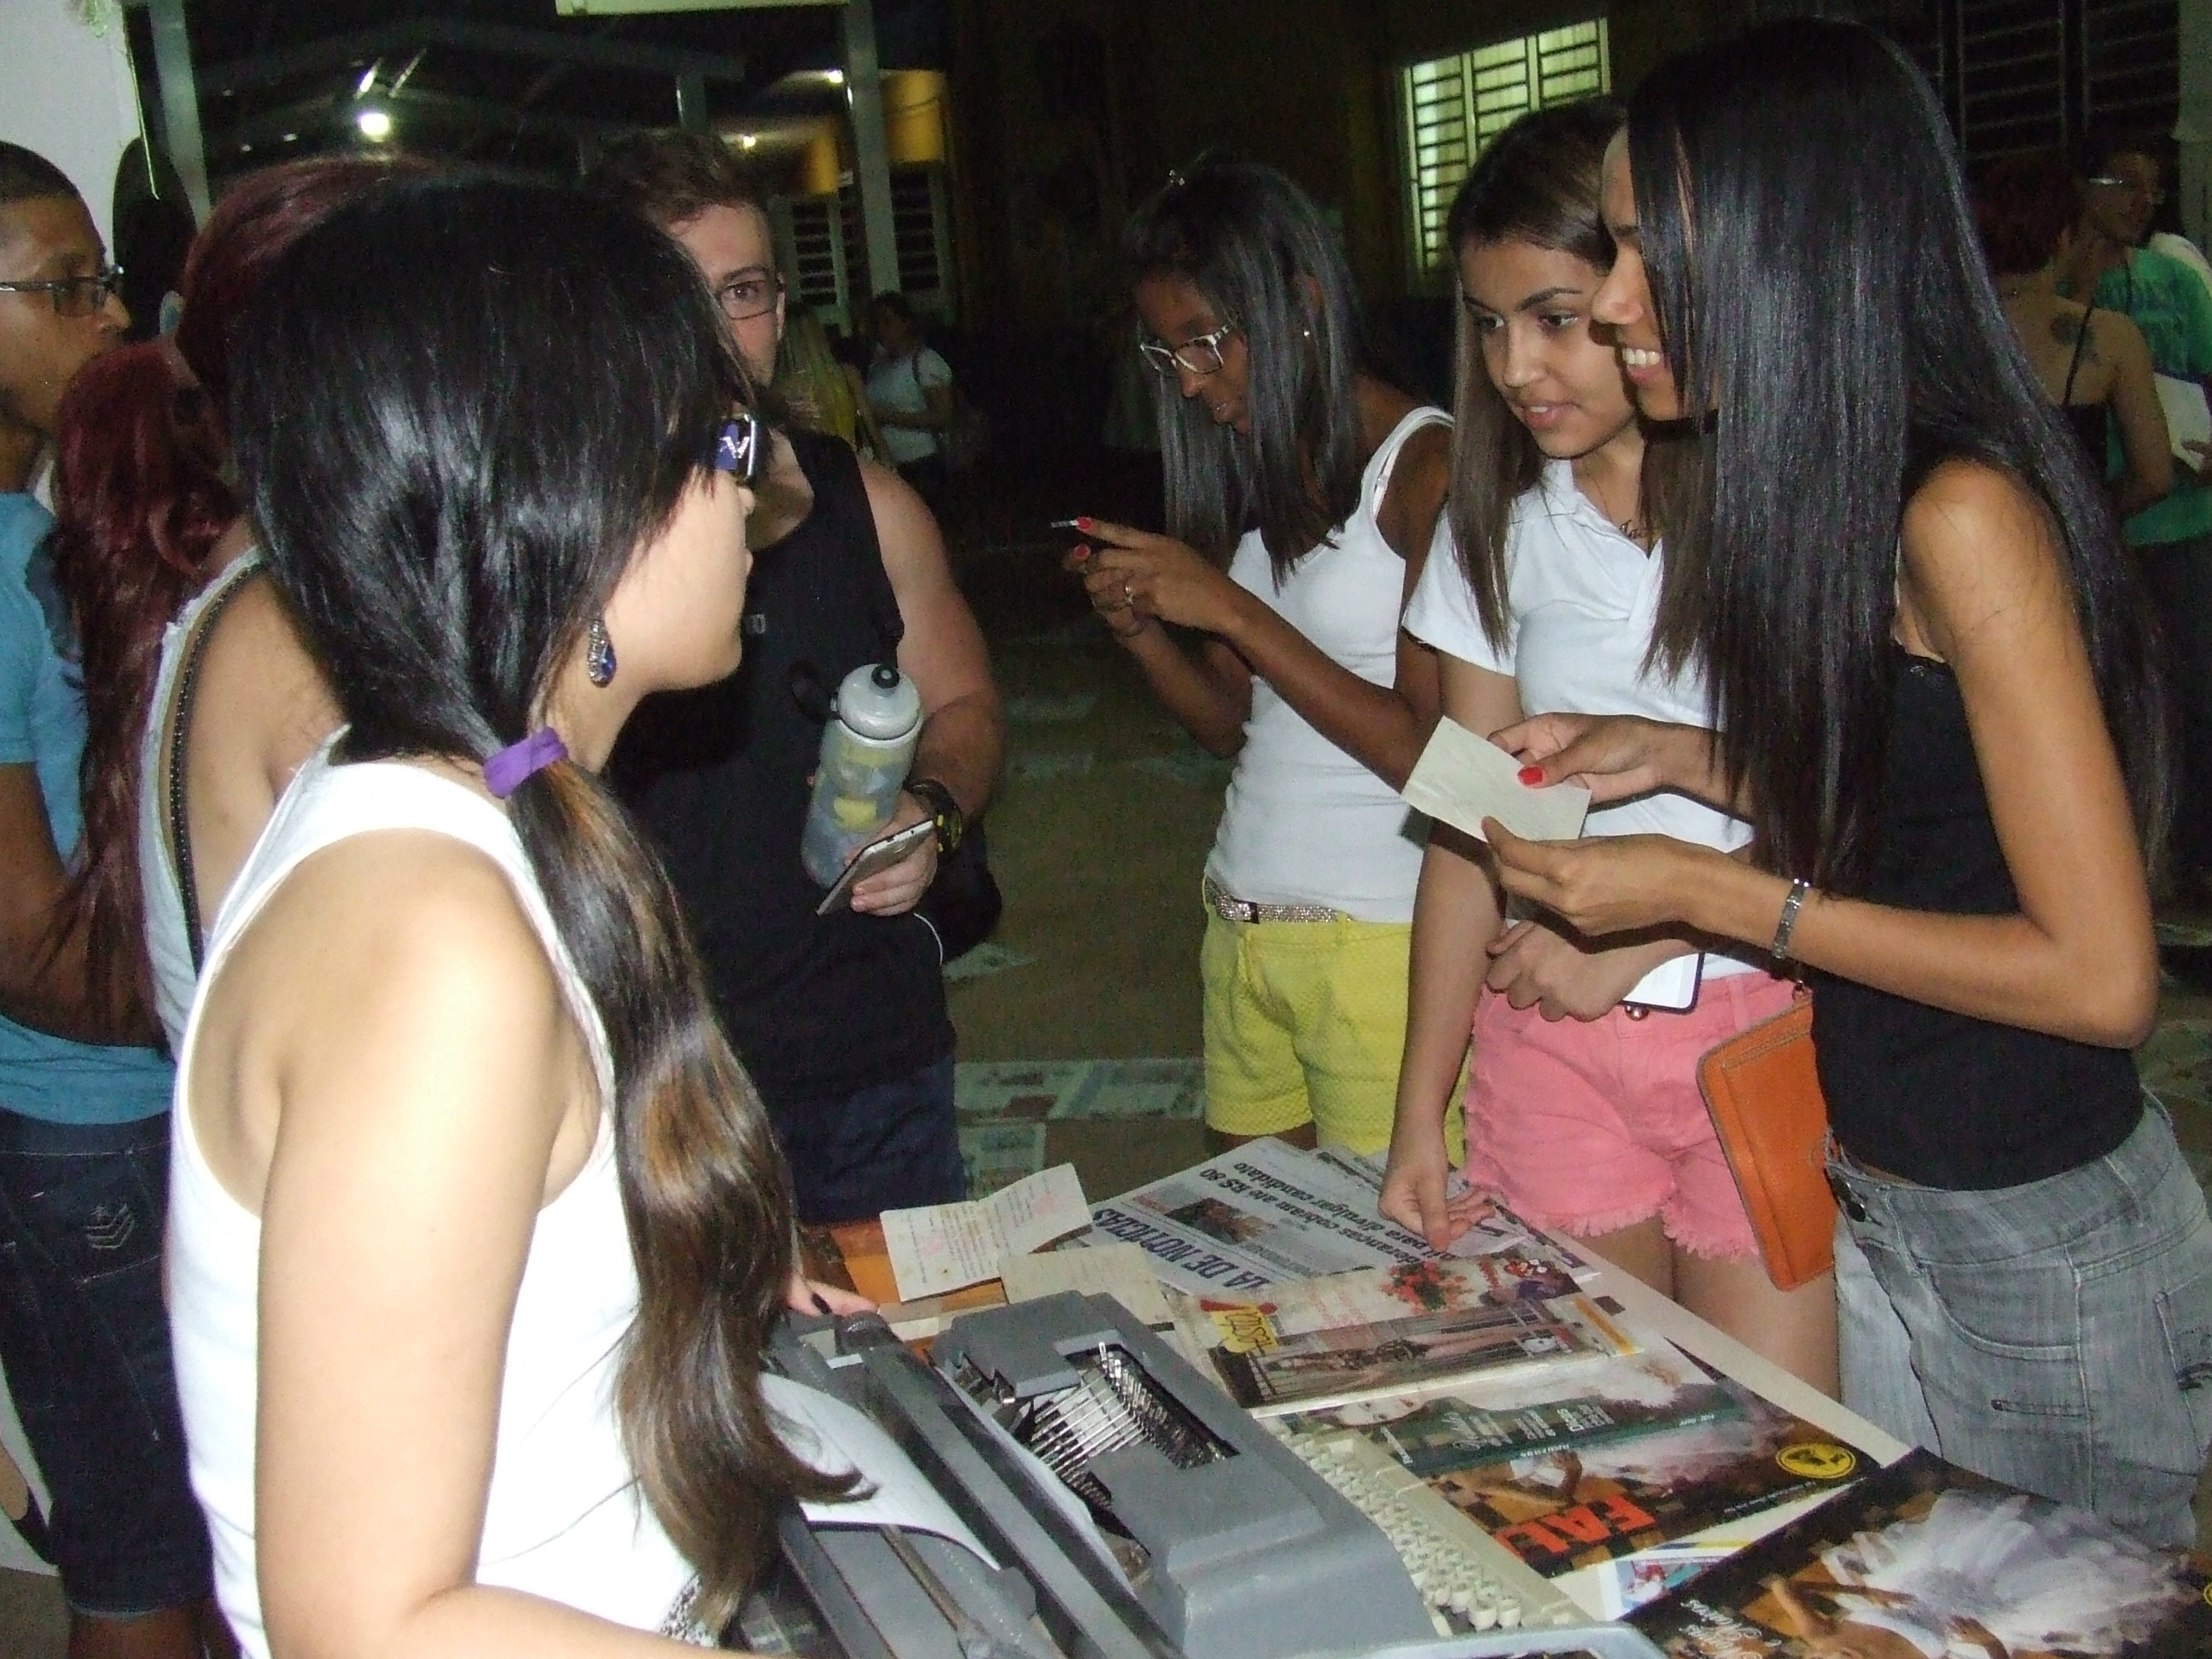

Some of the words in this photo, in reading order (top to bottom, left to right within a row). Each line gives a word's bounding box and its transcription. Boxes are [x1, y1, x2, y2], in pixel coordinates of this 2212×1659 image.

[1199, 1168, 1226, 1181] 80
[1233, 1162, 1314, 1201] candidato
[1276, 1202, 1340, 1229] cobram
[1310, 1199, 1385, 1231] divulgar
[1385, 1230, 1429, 1249] para
[1181, 1254, 1240, 1278] DE
